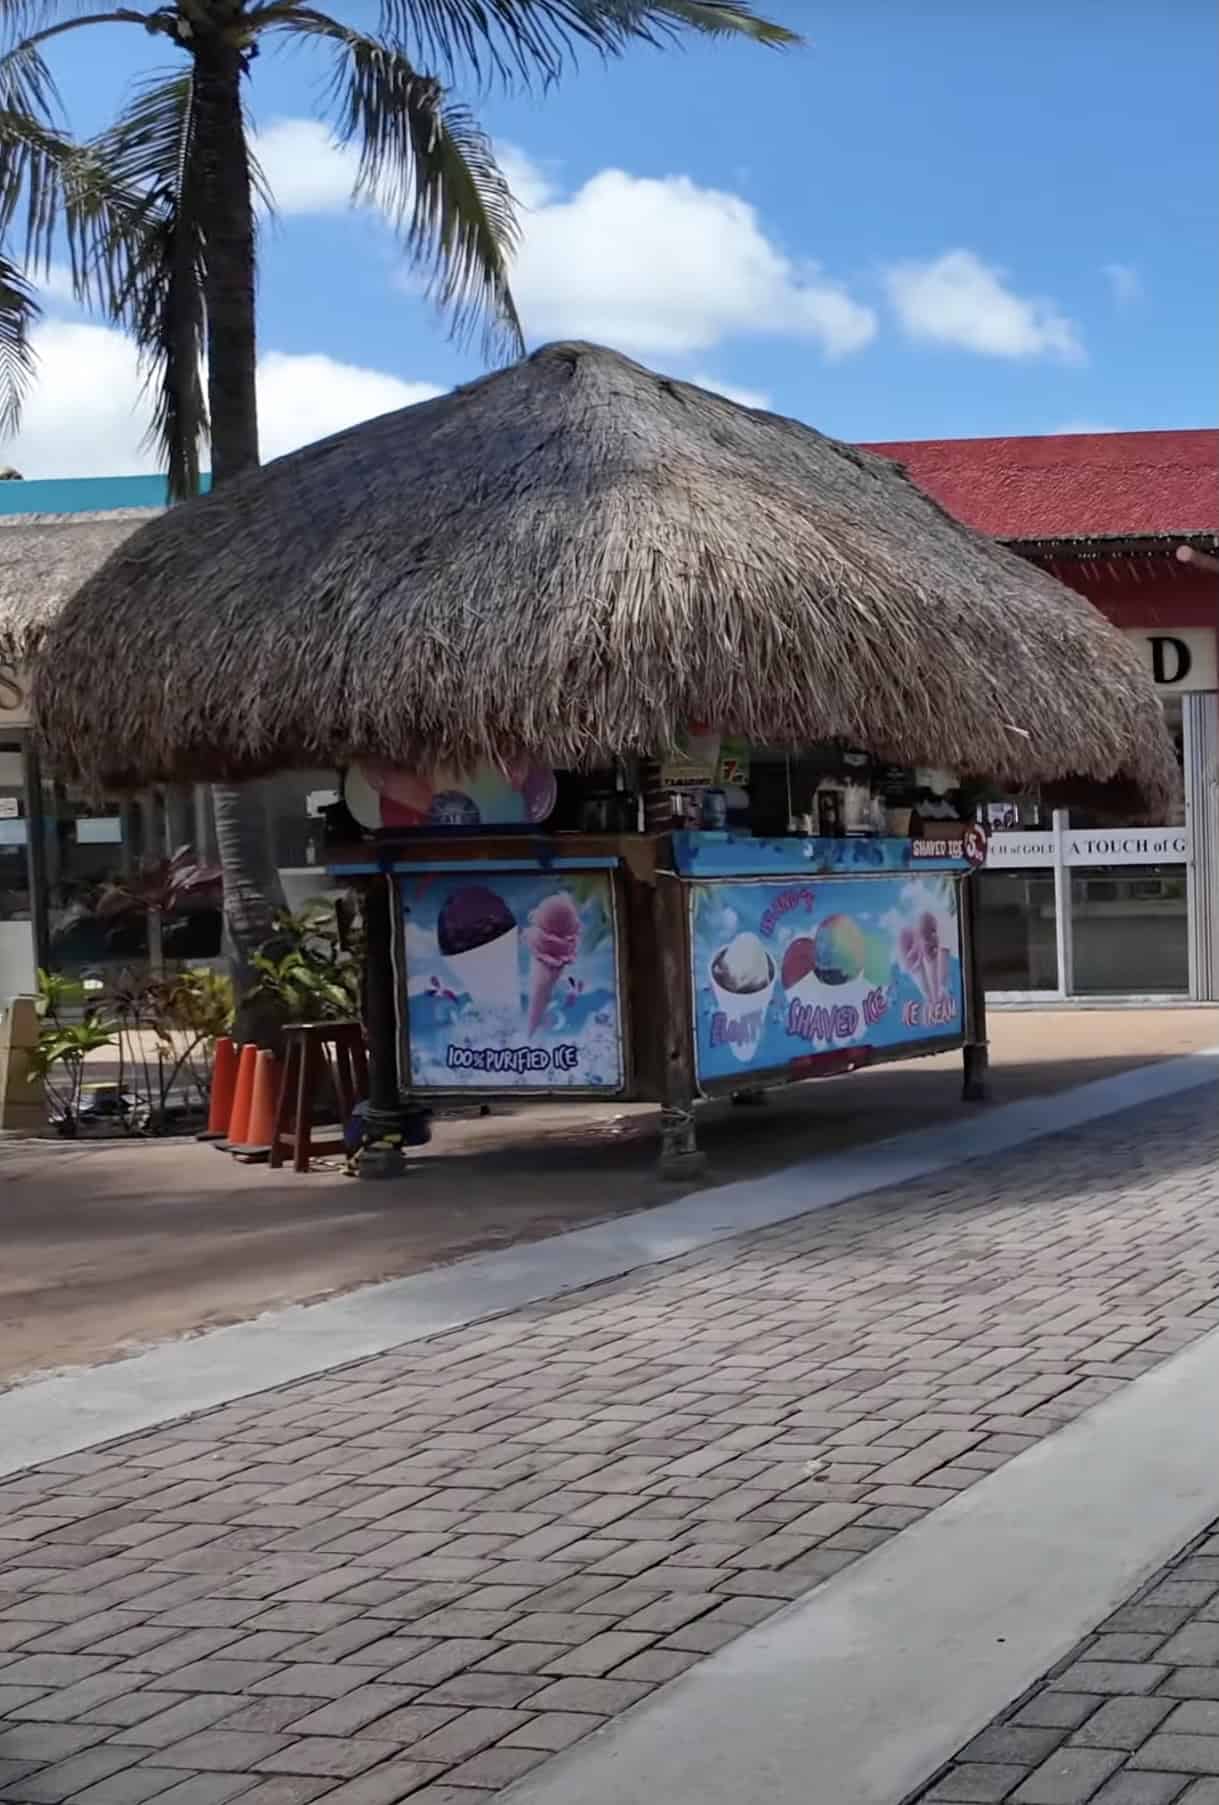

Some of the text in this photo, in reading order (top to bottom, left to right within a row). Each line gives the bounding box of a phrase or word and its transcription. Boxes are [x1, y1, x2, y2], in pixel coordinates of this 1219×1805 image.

[1147, 636, 1191, 684] D
[912, 839, 945, 857] SHAVED
[947, 838, 964, 859] ICE
[1084, 838, 1148, 855] TOUCH
[785, 997, 861, 1042] SHAVED
[862, 983, 889, 1026] ICE
[553, 1043, 579, 1071] ICE
